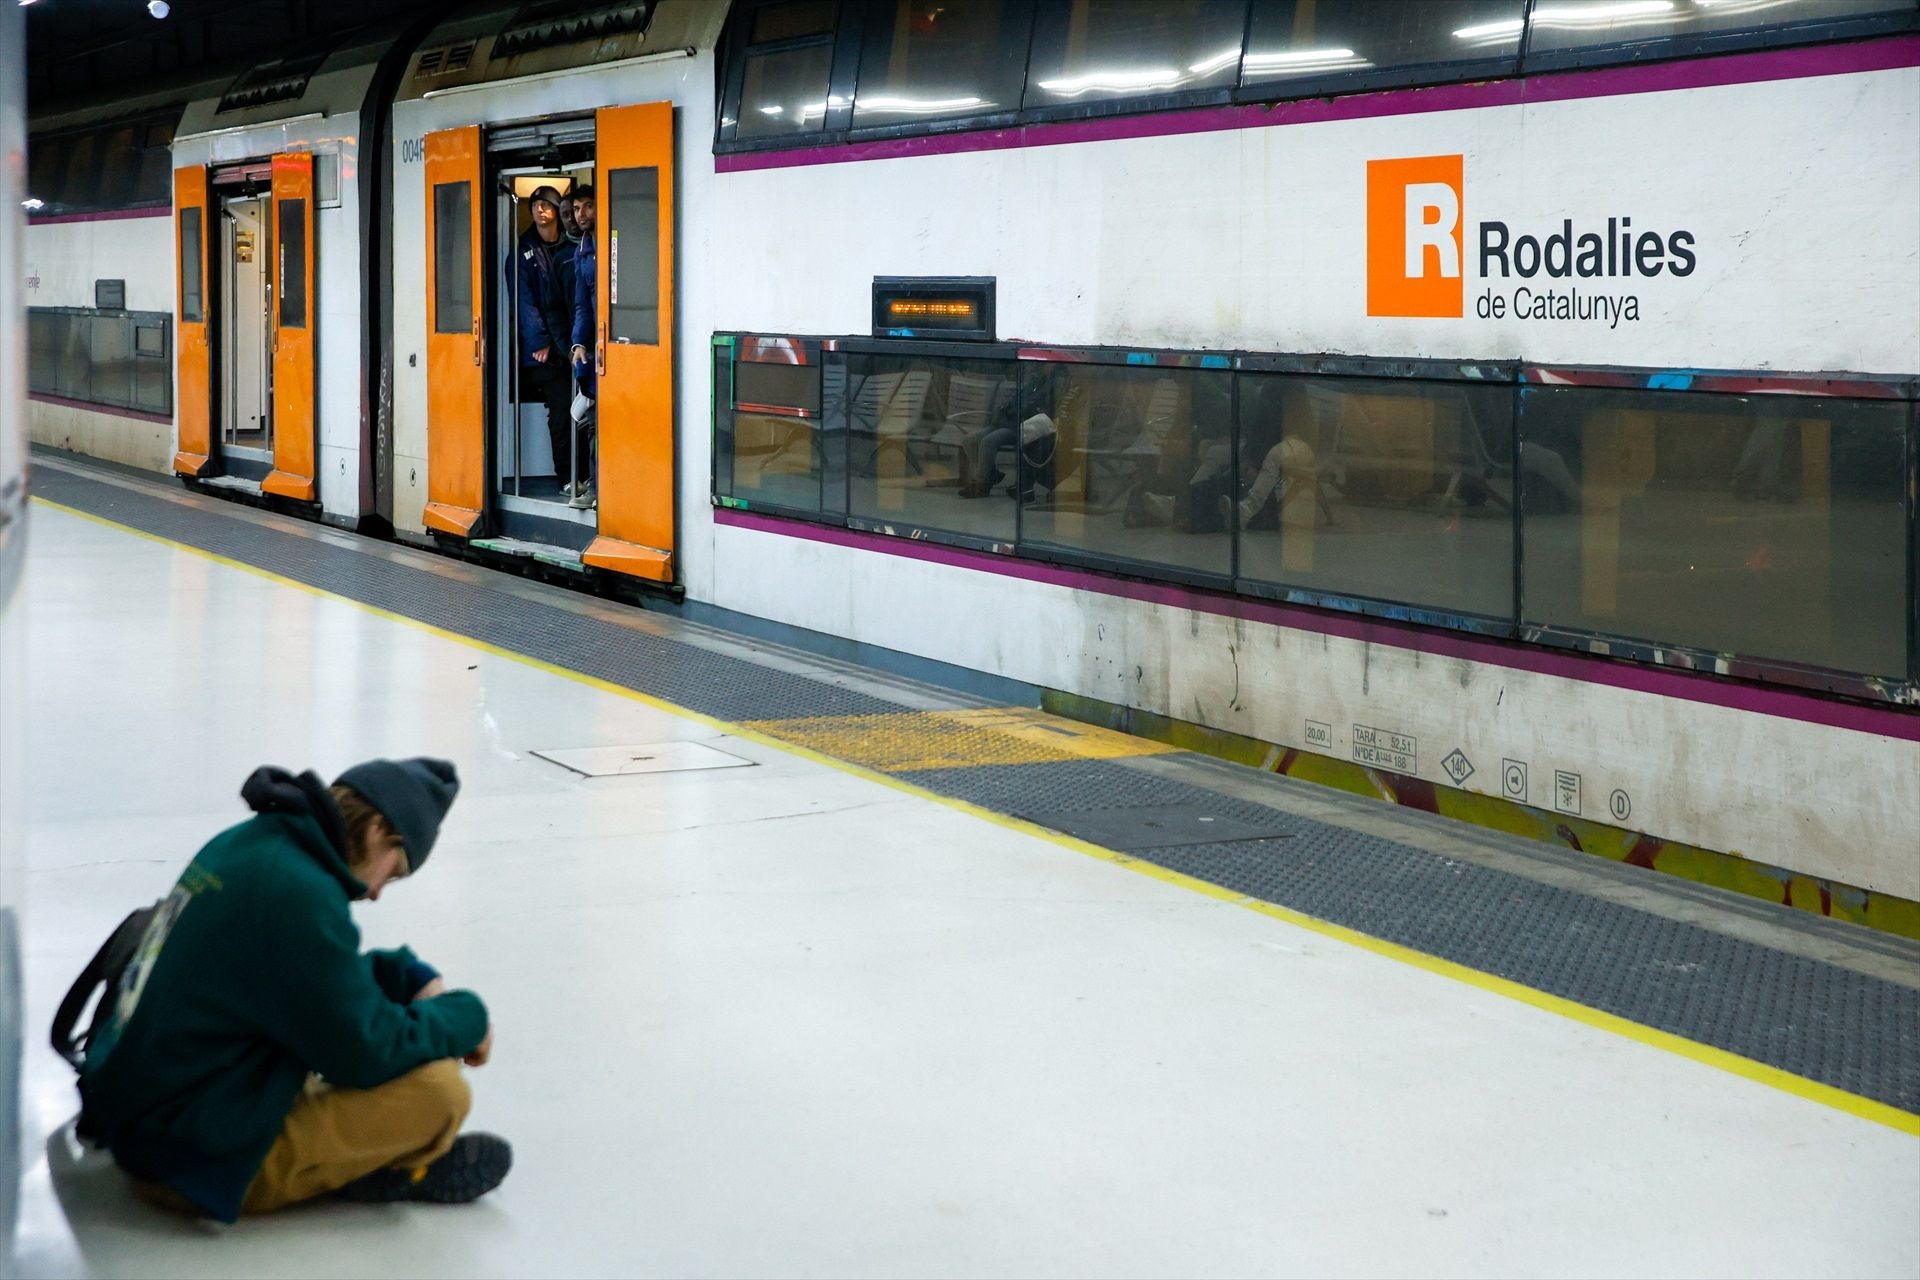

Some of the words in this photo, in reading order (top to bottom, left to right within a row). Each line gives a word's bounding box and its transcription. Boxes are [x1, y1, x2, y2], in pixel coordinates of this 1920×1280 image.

[1405, 182, 1460, 278] R
[1479, 216, 1697, 278] Rodalies
[1476, 288, 1506, 319] de
[1513, 286, 1640, 329] Catalunya
[1355, 728, 1375, 744] TARA
[1450, 757, 1466, 777] 140
